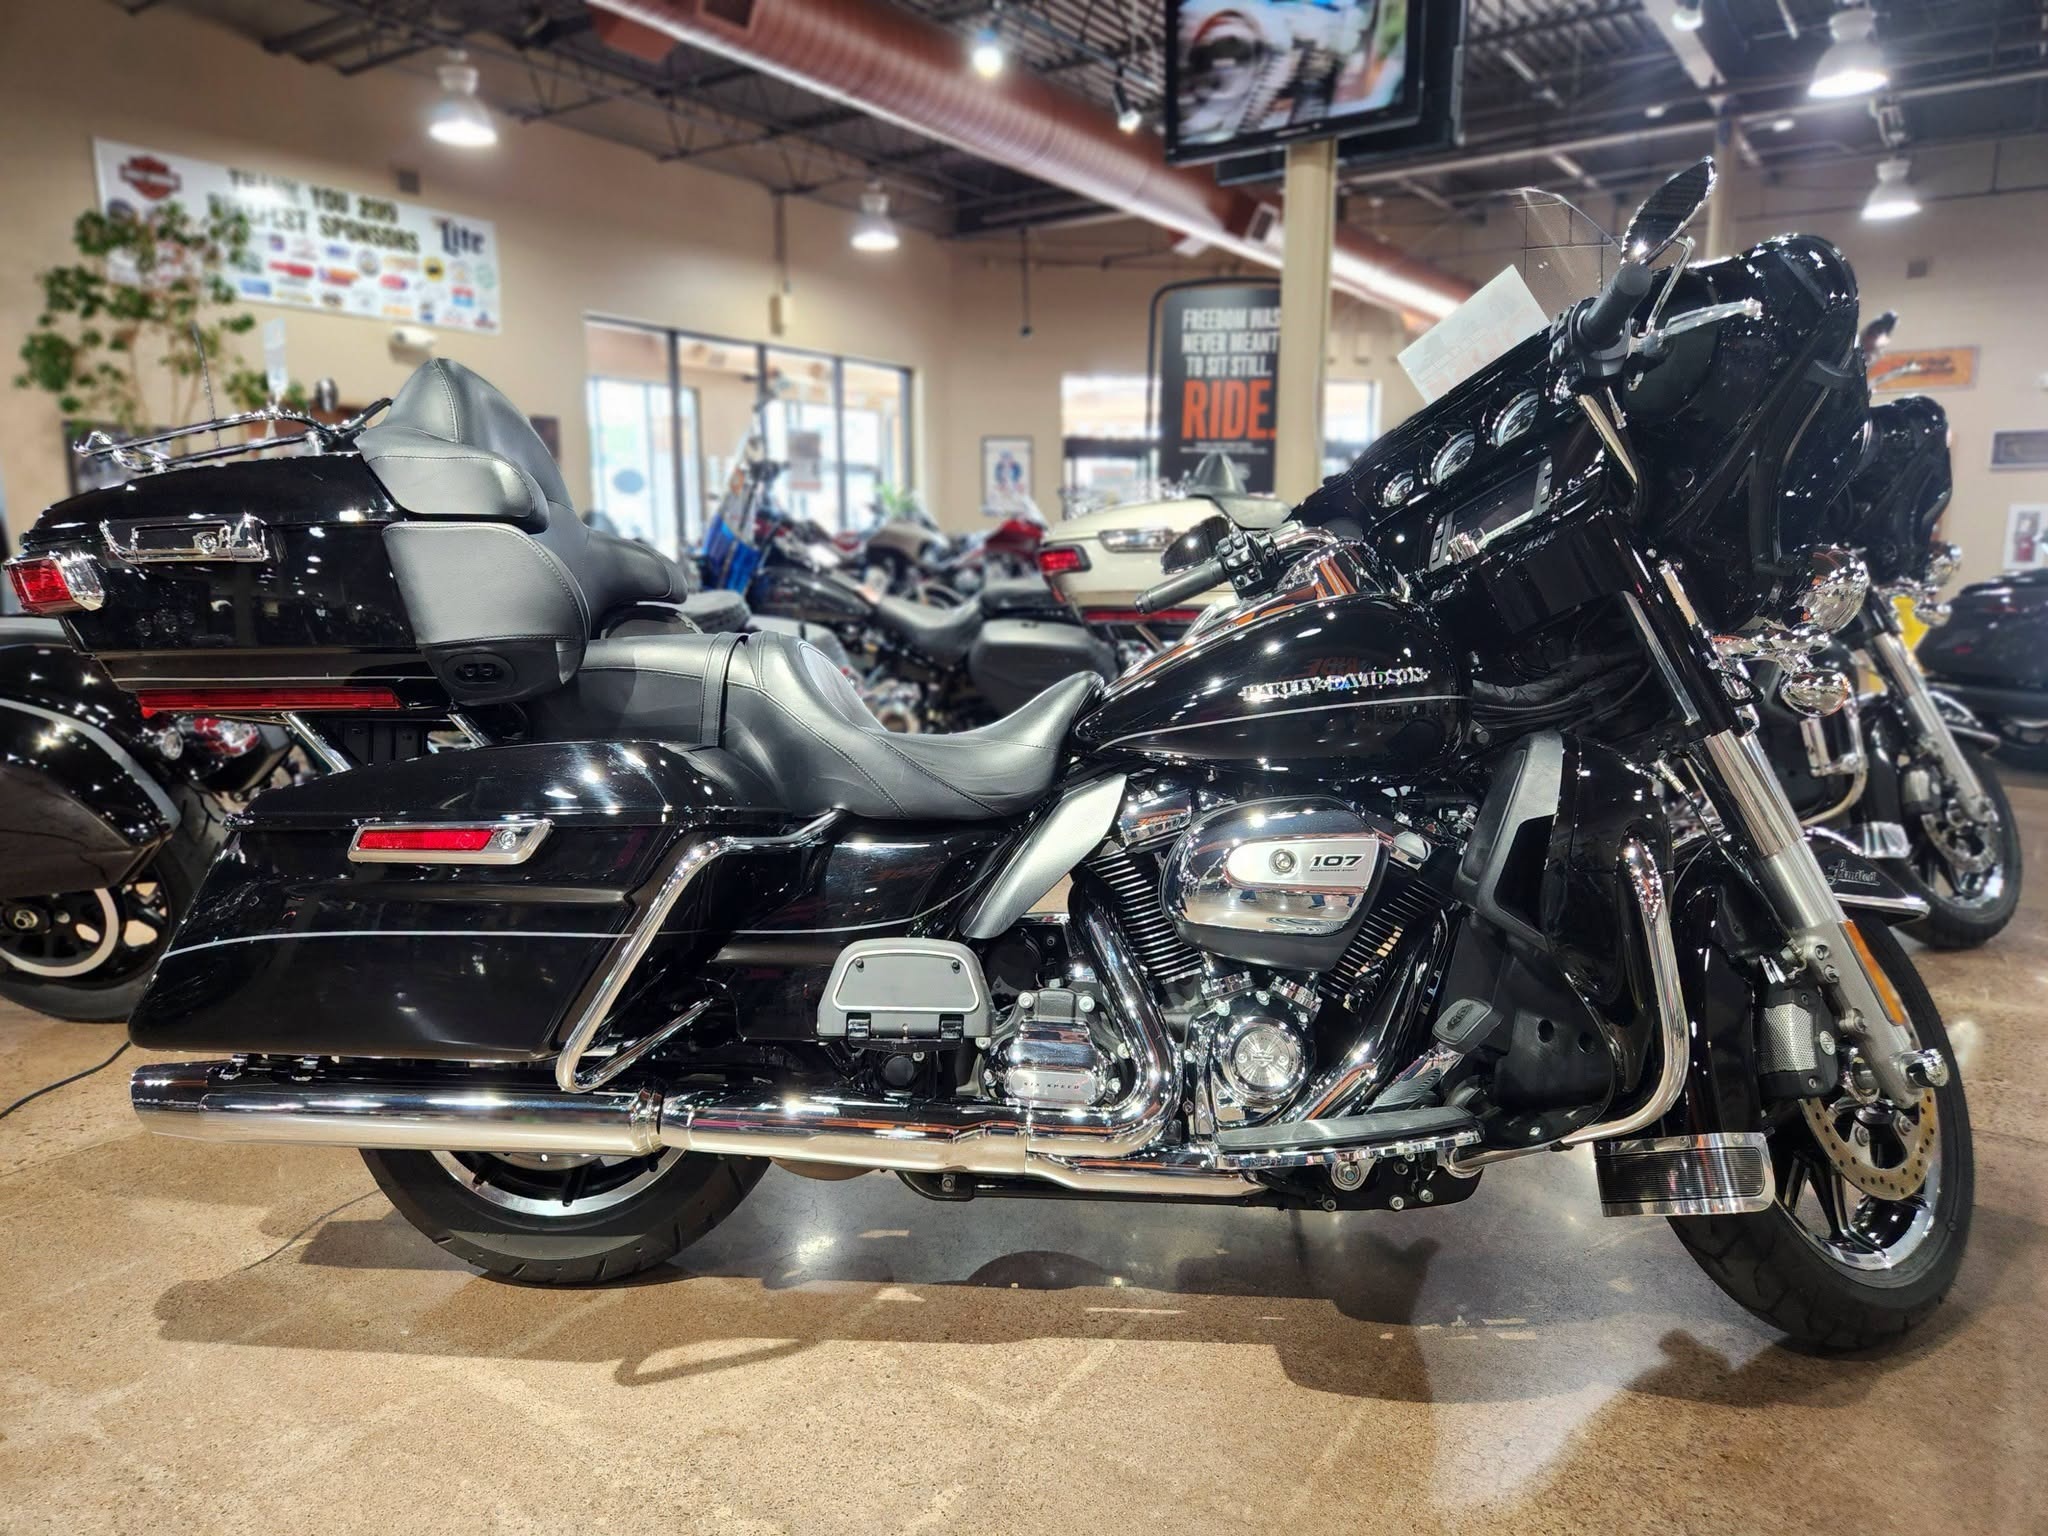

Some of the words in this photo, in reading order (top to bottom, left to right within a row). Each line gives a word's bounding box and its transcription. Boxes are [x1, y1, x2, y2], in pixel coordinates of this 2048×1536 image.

[309, 185, 349, 213] YOU
[319, 214, 420, 254] SPONSORS
[1182, 307, 1247, 330] FREEDOM
[1181, 331, 1228, 353] NEVER
[1186, 355, 1204, 376] TO
[1205, 355, 1229, 376] SIT
[1230, 355, 1272, 377] STILL.
[1181, 379, 1277, 440] RIDE.
[1311, 854, 1364, 868] 107
